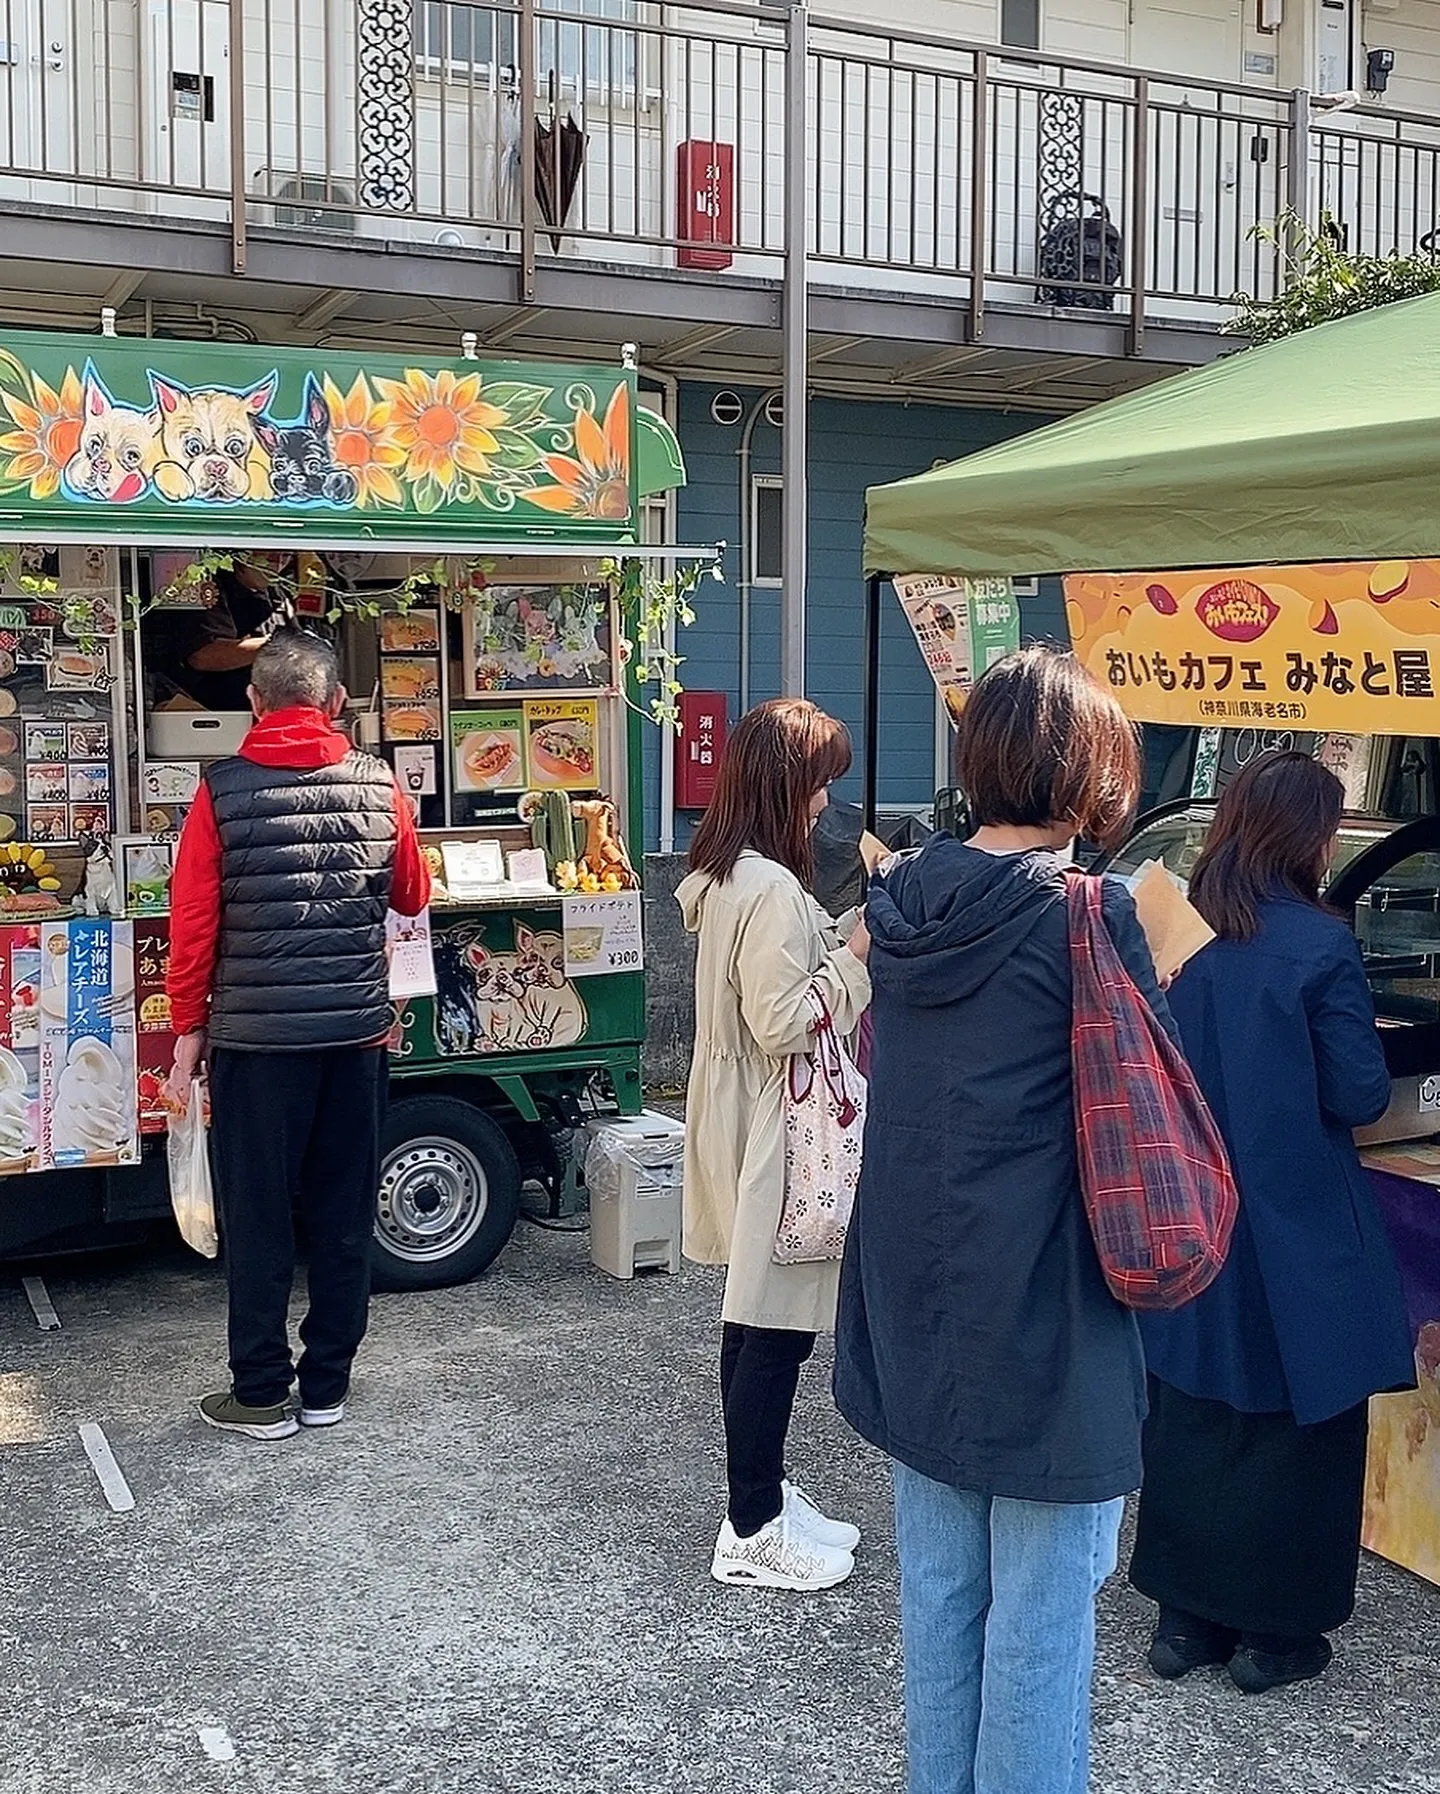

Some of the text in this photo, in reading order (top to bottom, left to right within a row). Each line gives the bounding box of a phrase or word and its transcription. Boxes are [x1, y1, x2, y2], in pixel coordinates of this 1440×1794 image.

[976, 601, 1010, 625] 募集中
[1106, 649, 1435, 698] おいもカフェ みなと屋
[1199, 700, 1307, 719] (神奈川県海老名市)
[700, 715, 713, 765] 消火器
[91, 930, 109, 986] 北海道
[608, 951, 639, 965] ¥300
